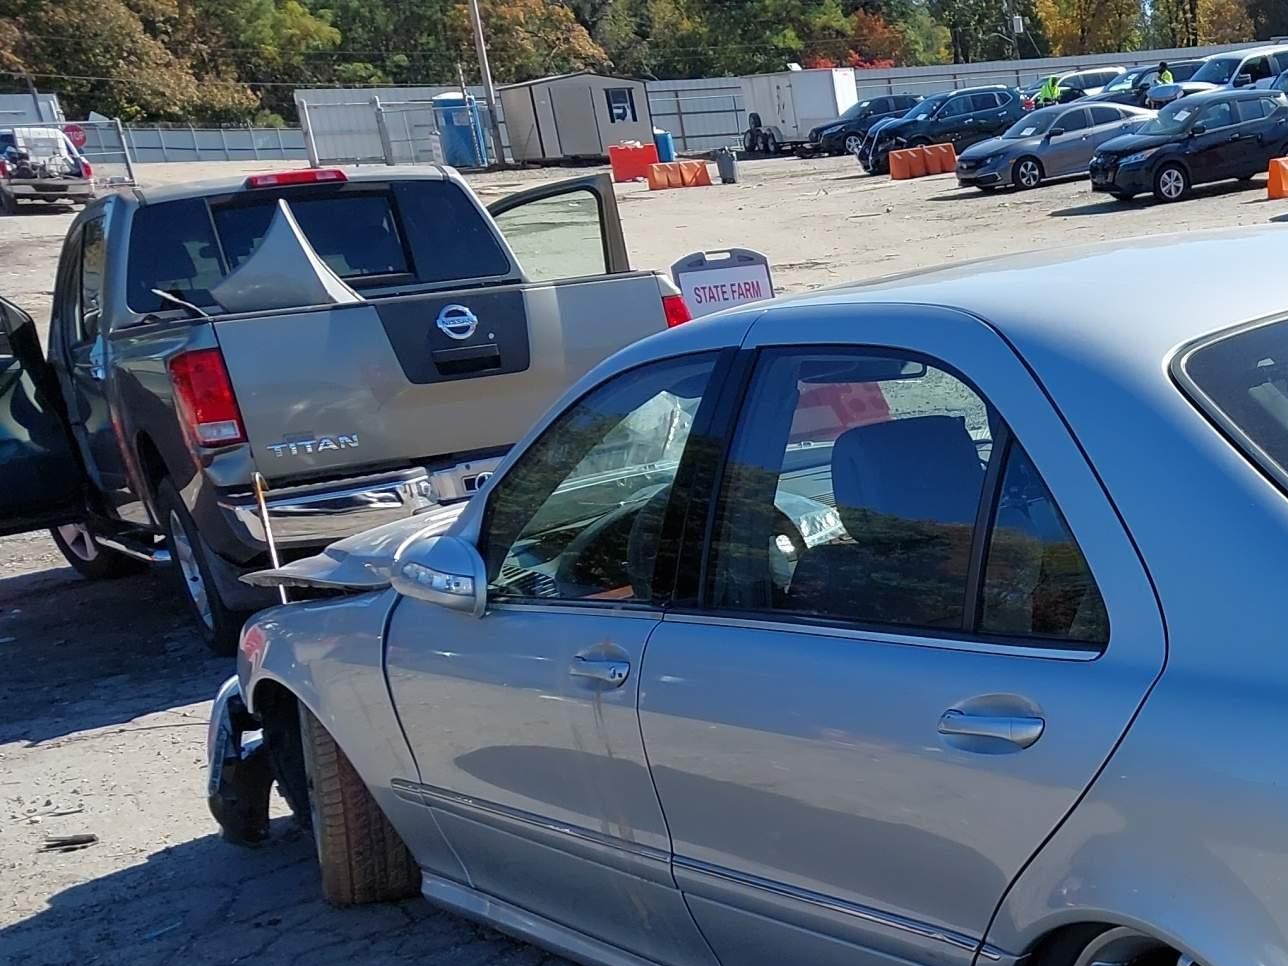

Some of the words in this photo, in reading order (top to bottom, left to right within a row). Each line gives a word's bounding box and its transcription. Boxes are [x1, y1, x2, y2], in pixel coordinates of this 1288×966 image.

[694, 284, 729, 304] STATE
[729, 280, 762, 301] FARM
[266, 432, 359, 457] TITAN
